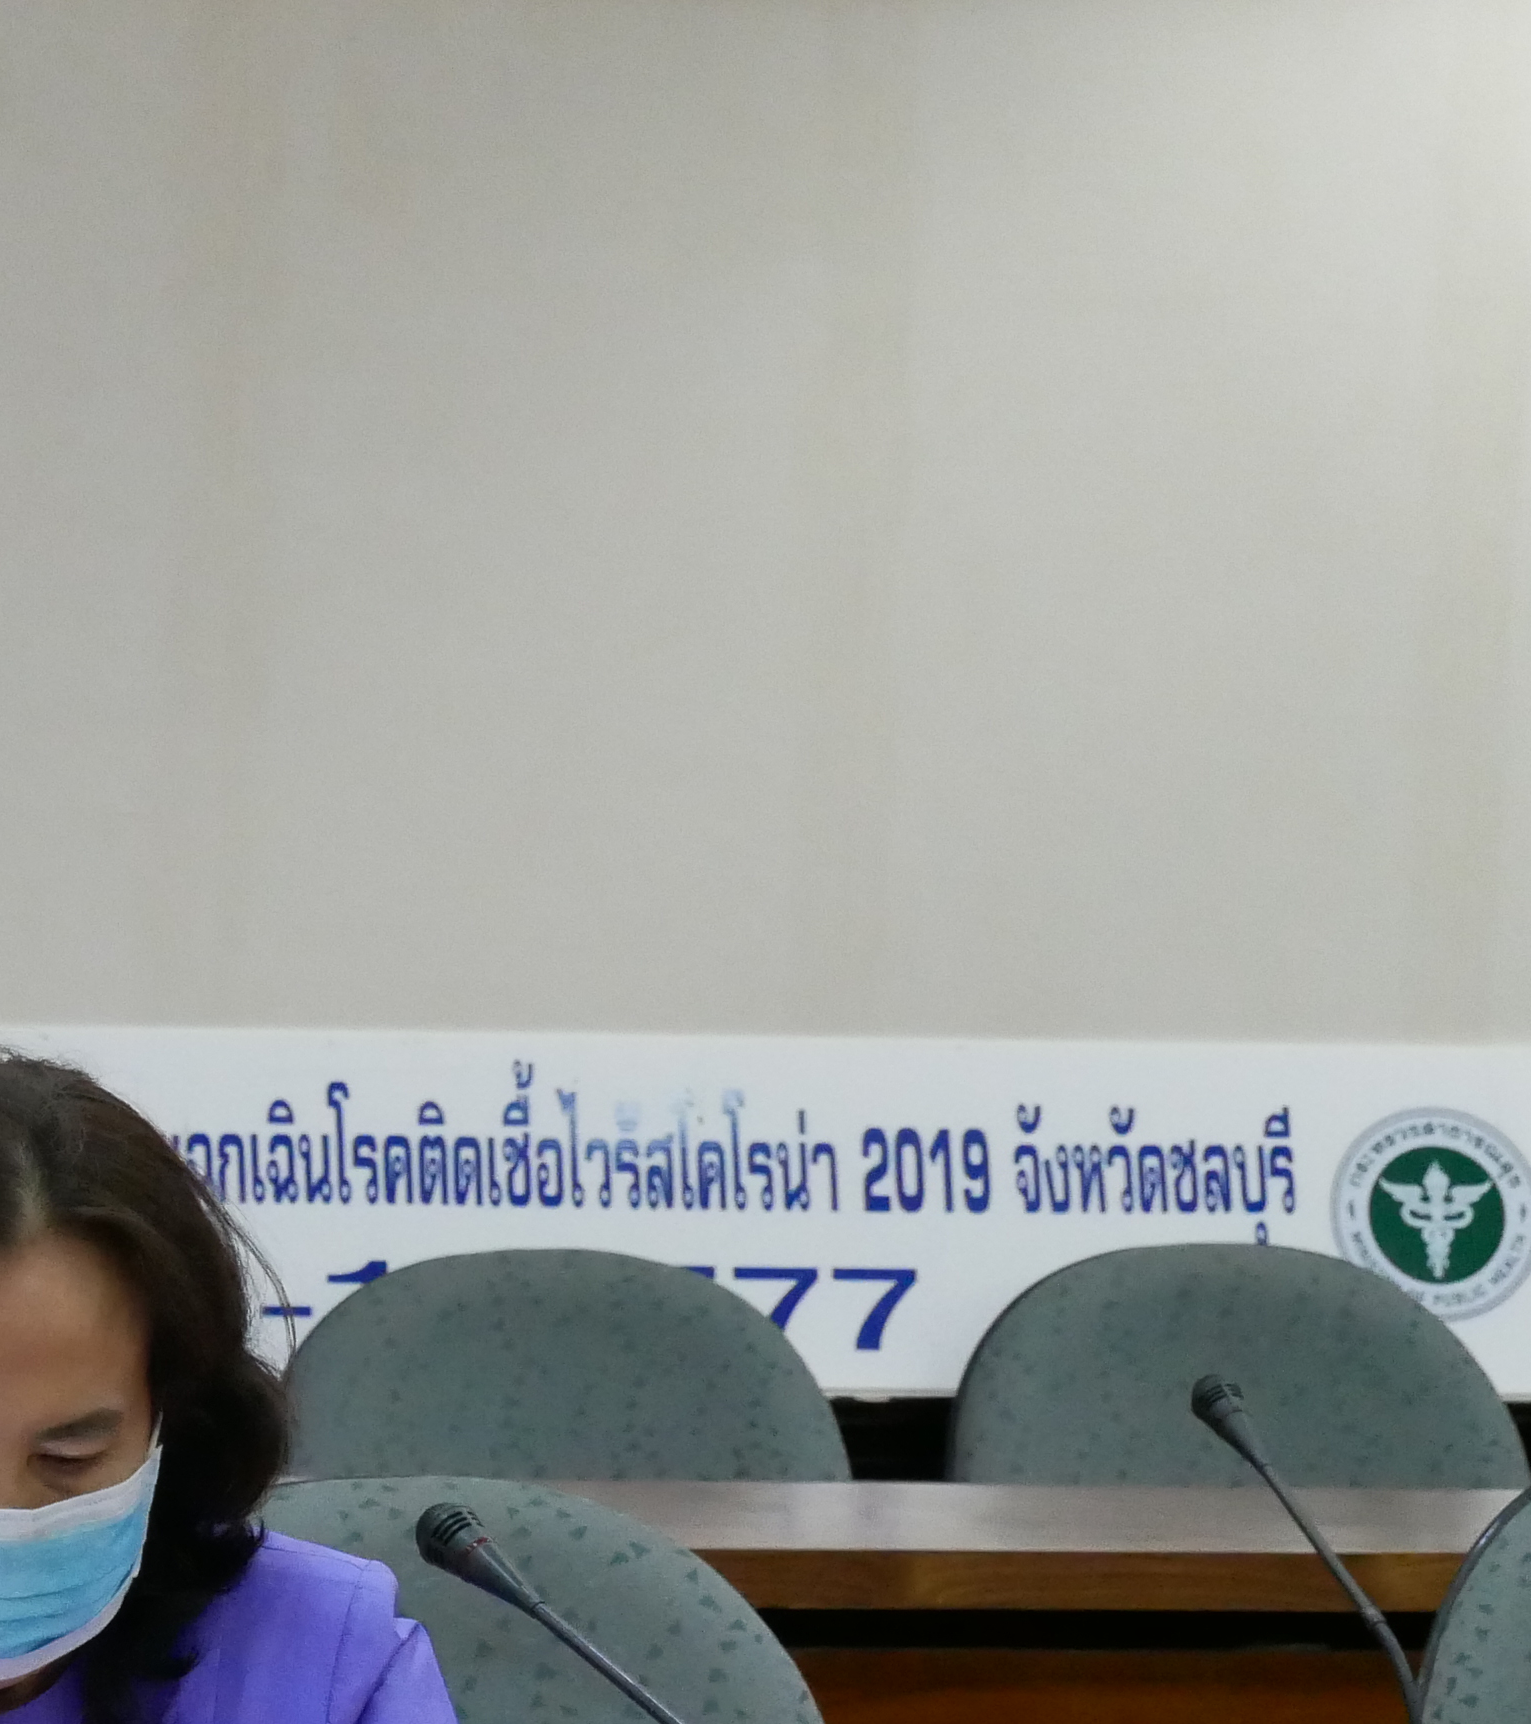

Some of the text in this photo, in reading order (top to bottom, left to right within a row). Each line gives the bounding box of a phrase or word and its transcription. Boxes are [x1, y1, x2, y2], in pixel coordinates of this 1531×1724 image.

[861, 1126, 990, 1214] 2019
[1014, 1103, 1295, 1246] จังหวัดชลบุรี
